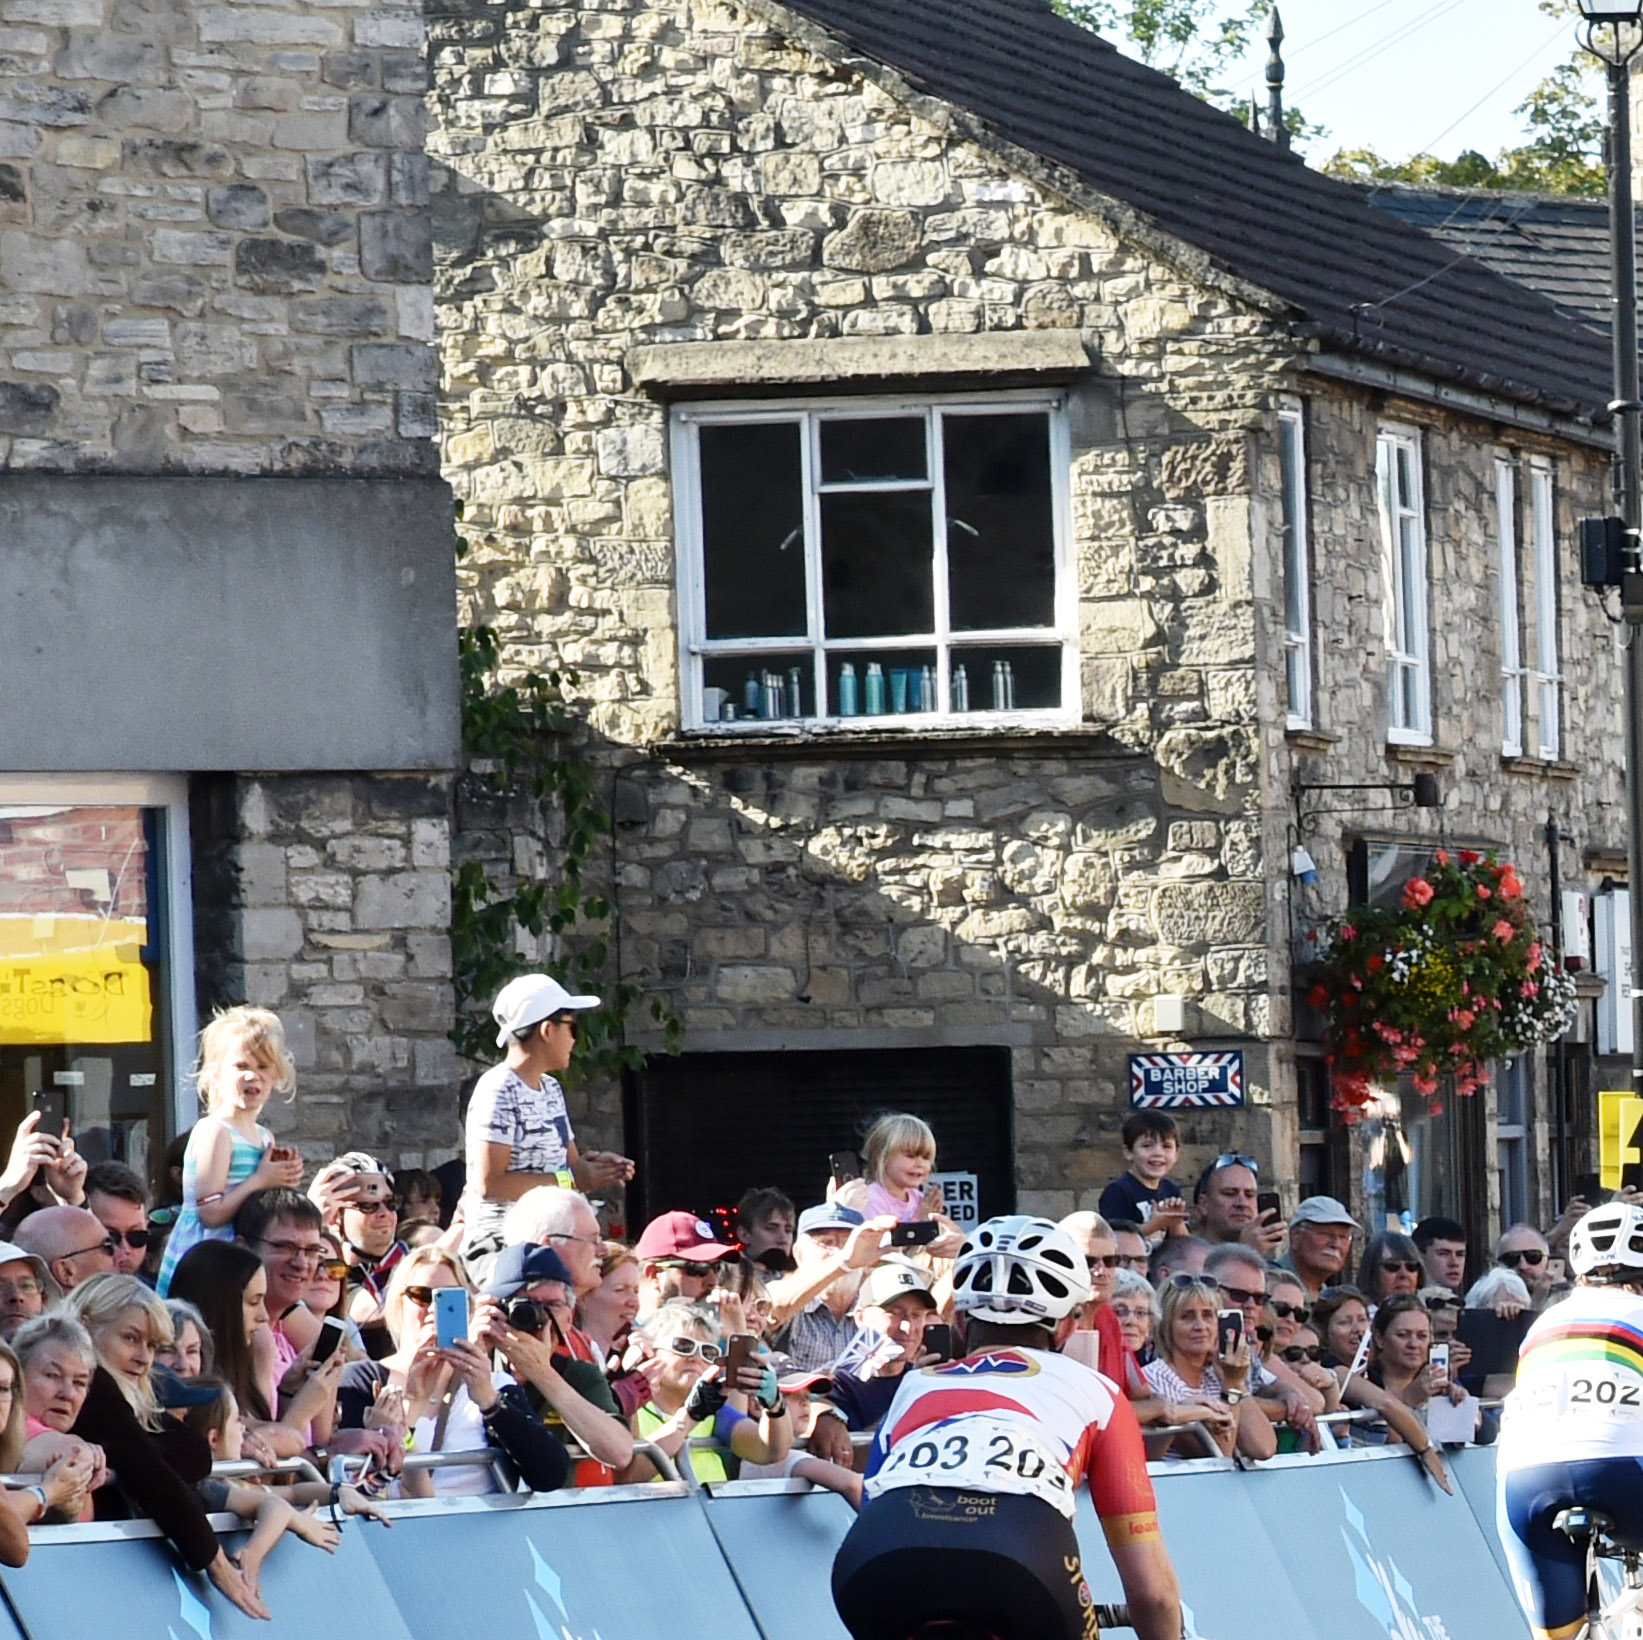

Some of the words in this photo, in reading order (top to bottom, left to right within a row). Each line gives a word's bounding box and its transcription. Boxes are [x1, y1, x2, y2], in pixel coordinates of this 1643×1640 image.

[1150, 1066, 1220, 1082] BARBER
[1162, 1080, 1209, 1094] SHOP
[1570, 1379, 1640, 1406] 202
[957, 1495, 997, 1506] boot
[965, 1506, 997, 1516] out
